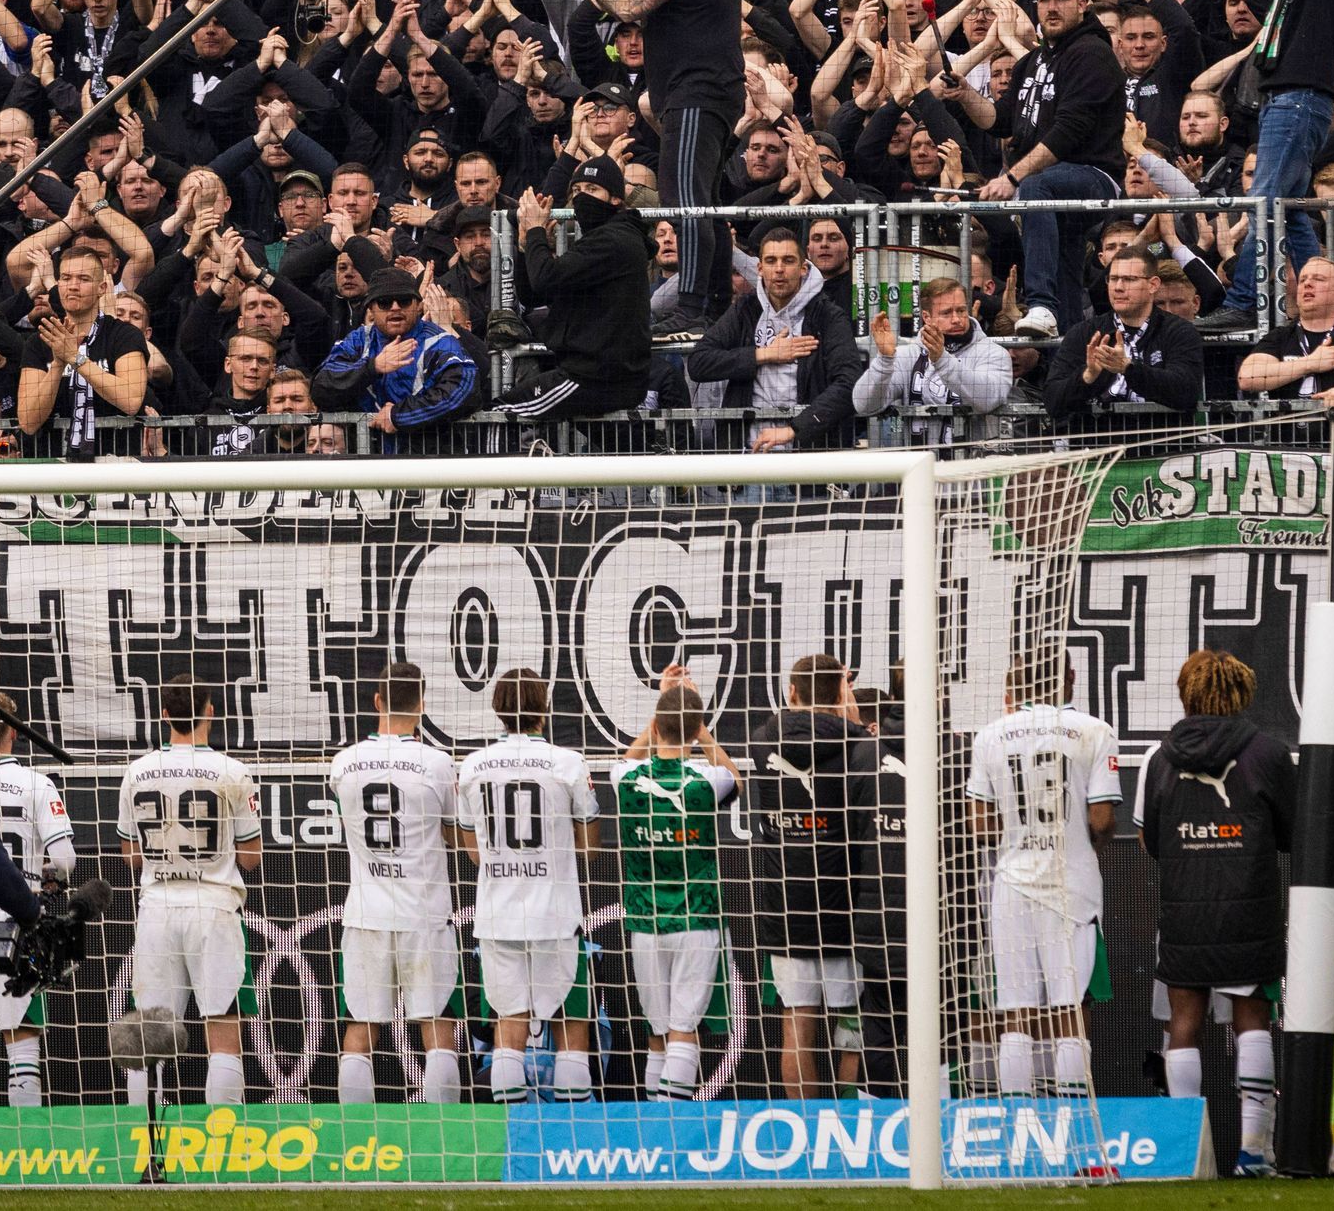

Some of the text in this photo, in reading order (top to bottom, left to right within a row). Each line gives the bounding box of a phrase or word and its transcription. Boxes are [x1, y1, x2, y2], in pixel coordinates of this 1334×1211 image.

[134, 789, 223, 864] 29
[362, 782, 405, 856] 8
[480, 781, 546, 855] 10
[1178, 821, 1244, 840] flatex
[485, 862, 548, 878] NEUHAUS
